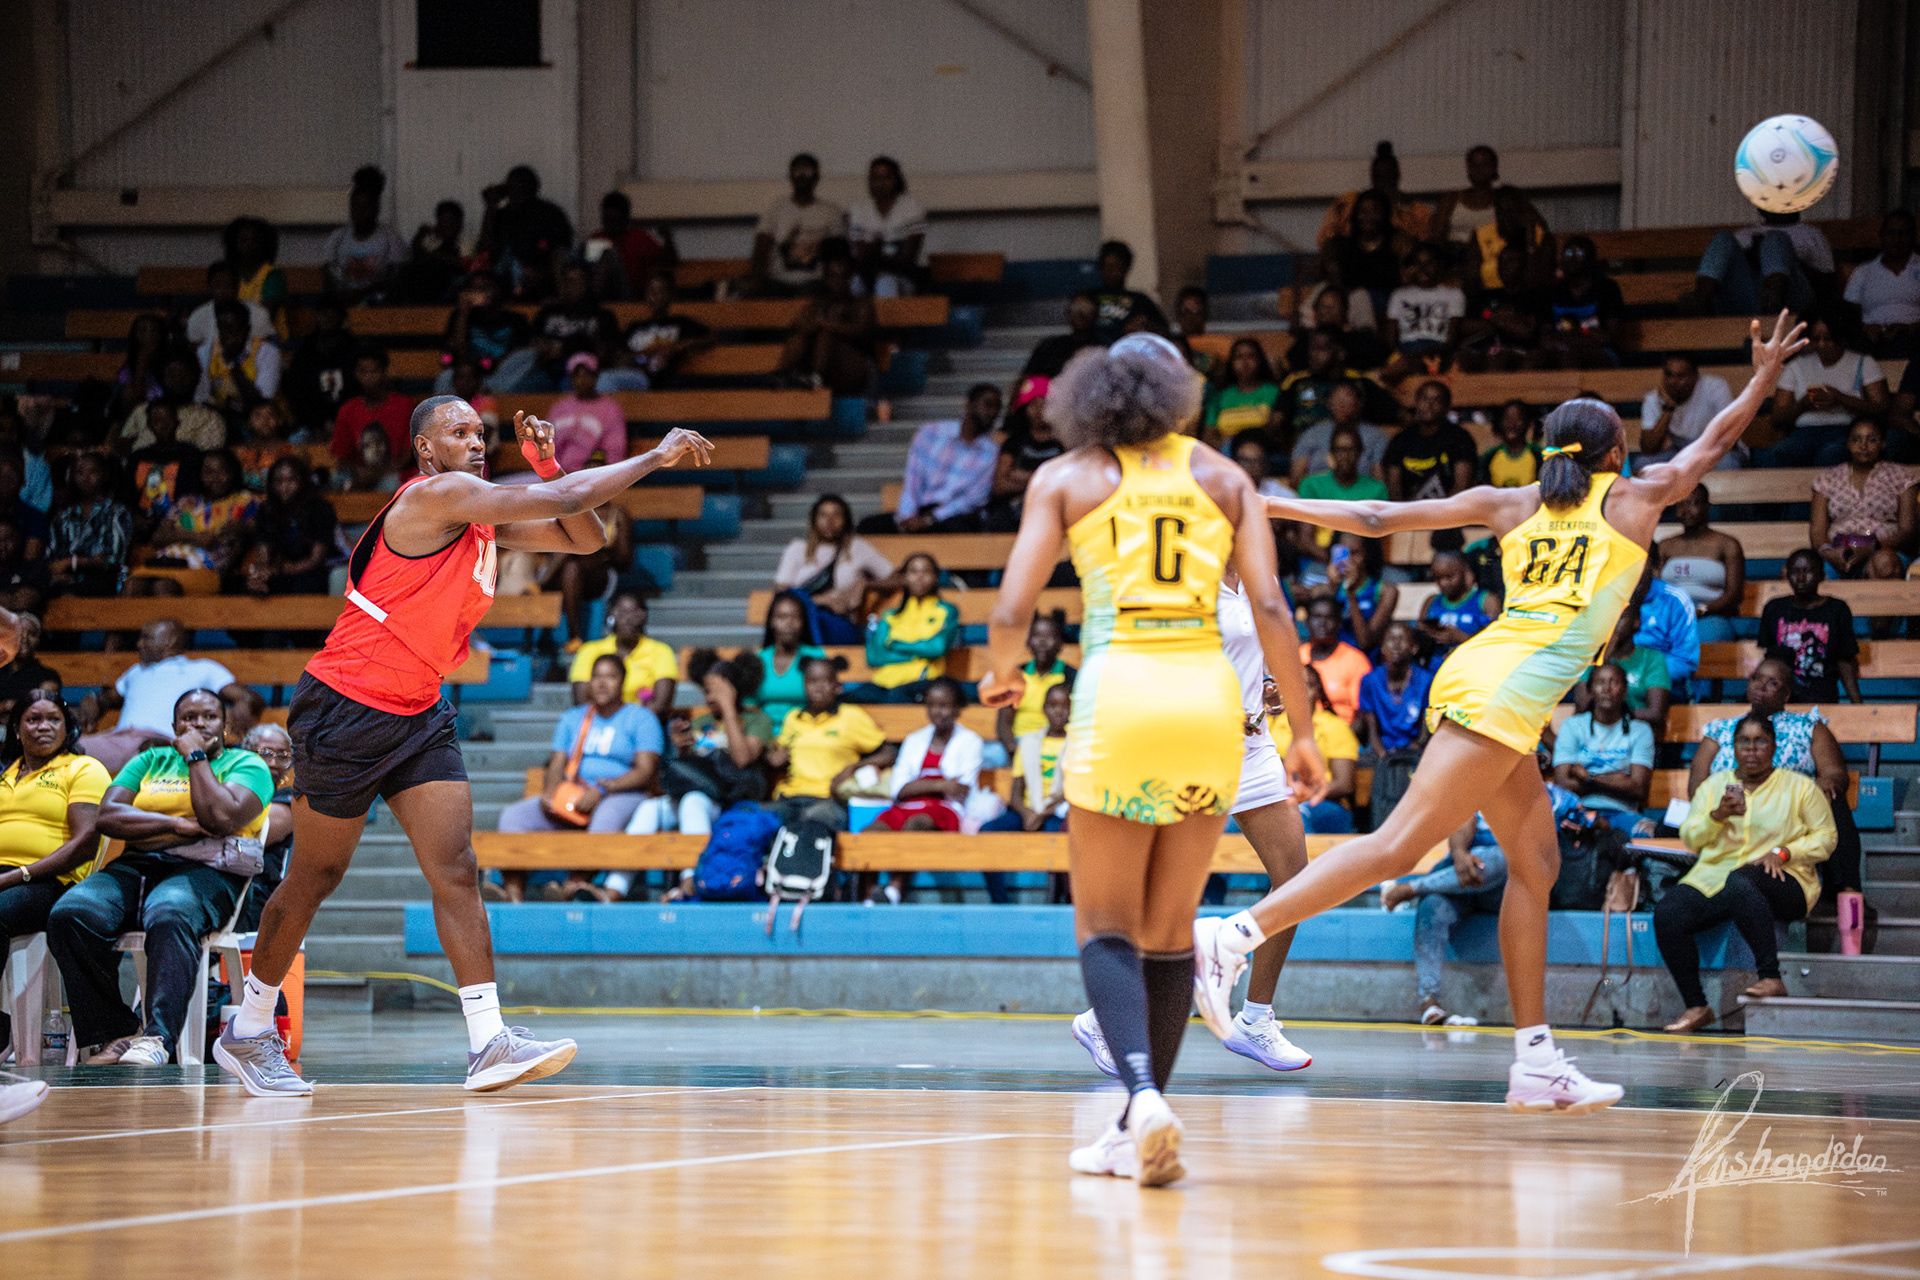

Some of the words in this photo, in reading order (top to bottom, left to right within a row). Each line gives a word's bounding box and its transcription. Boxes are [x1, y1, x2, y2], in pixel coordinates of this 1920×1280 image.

[1153, 514, 1188, 586] C
[1549, 520, 1598, 532] BECKFORD
[1520, 533, 1592, 587] GA
